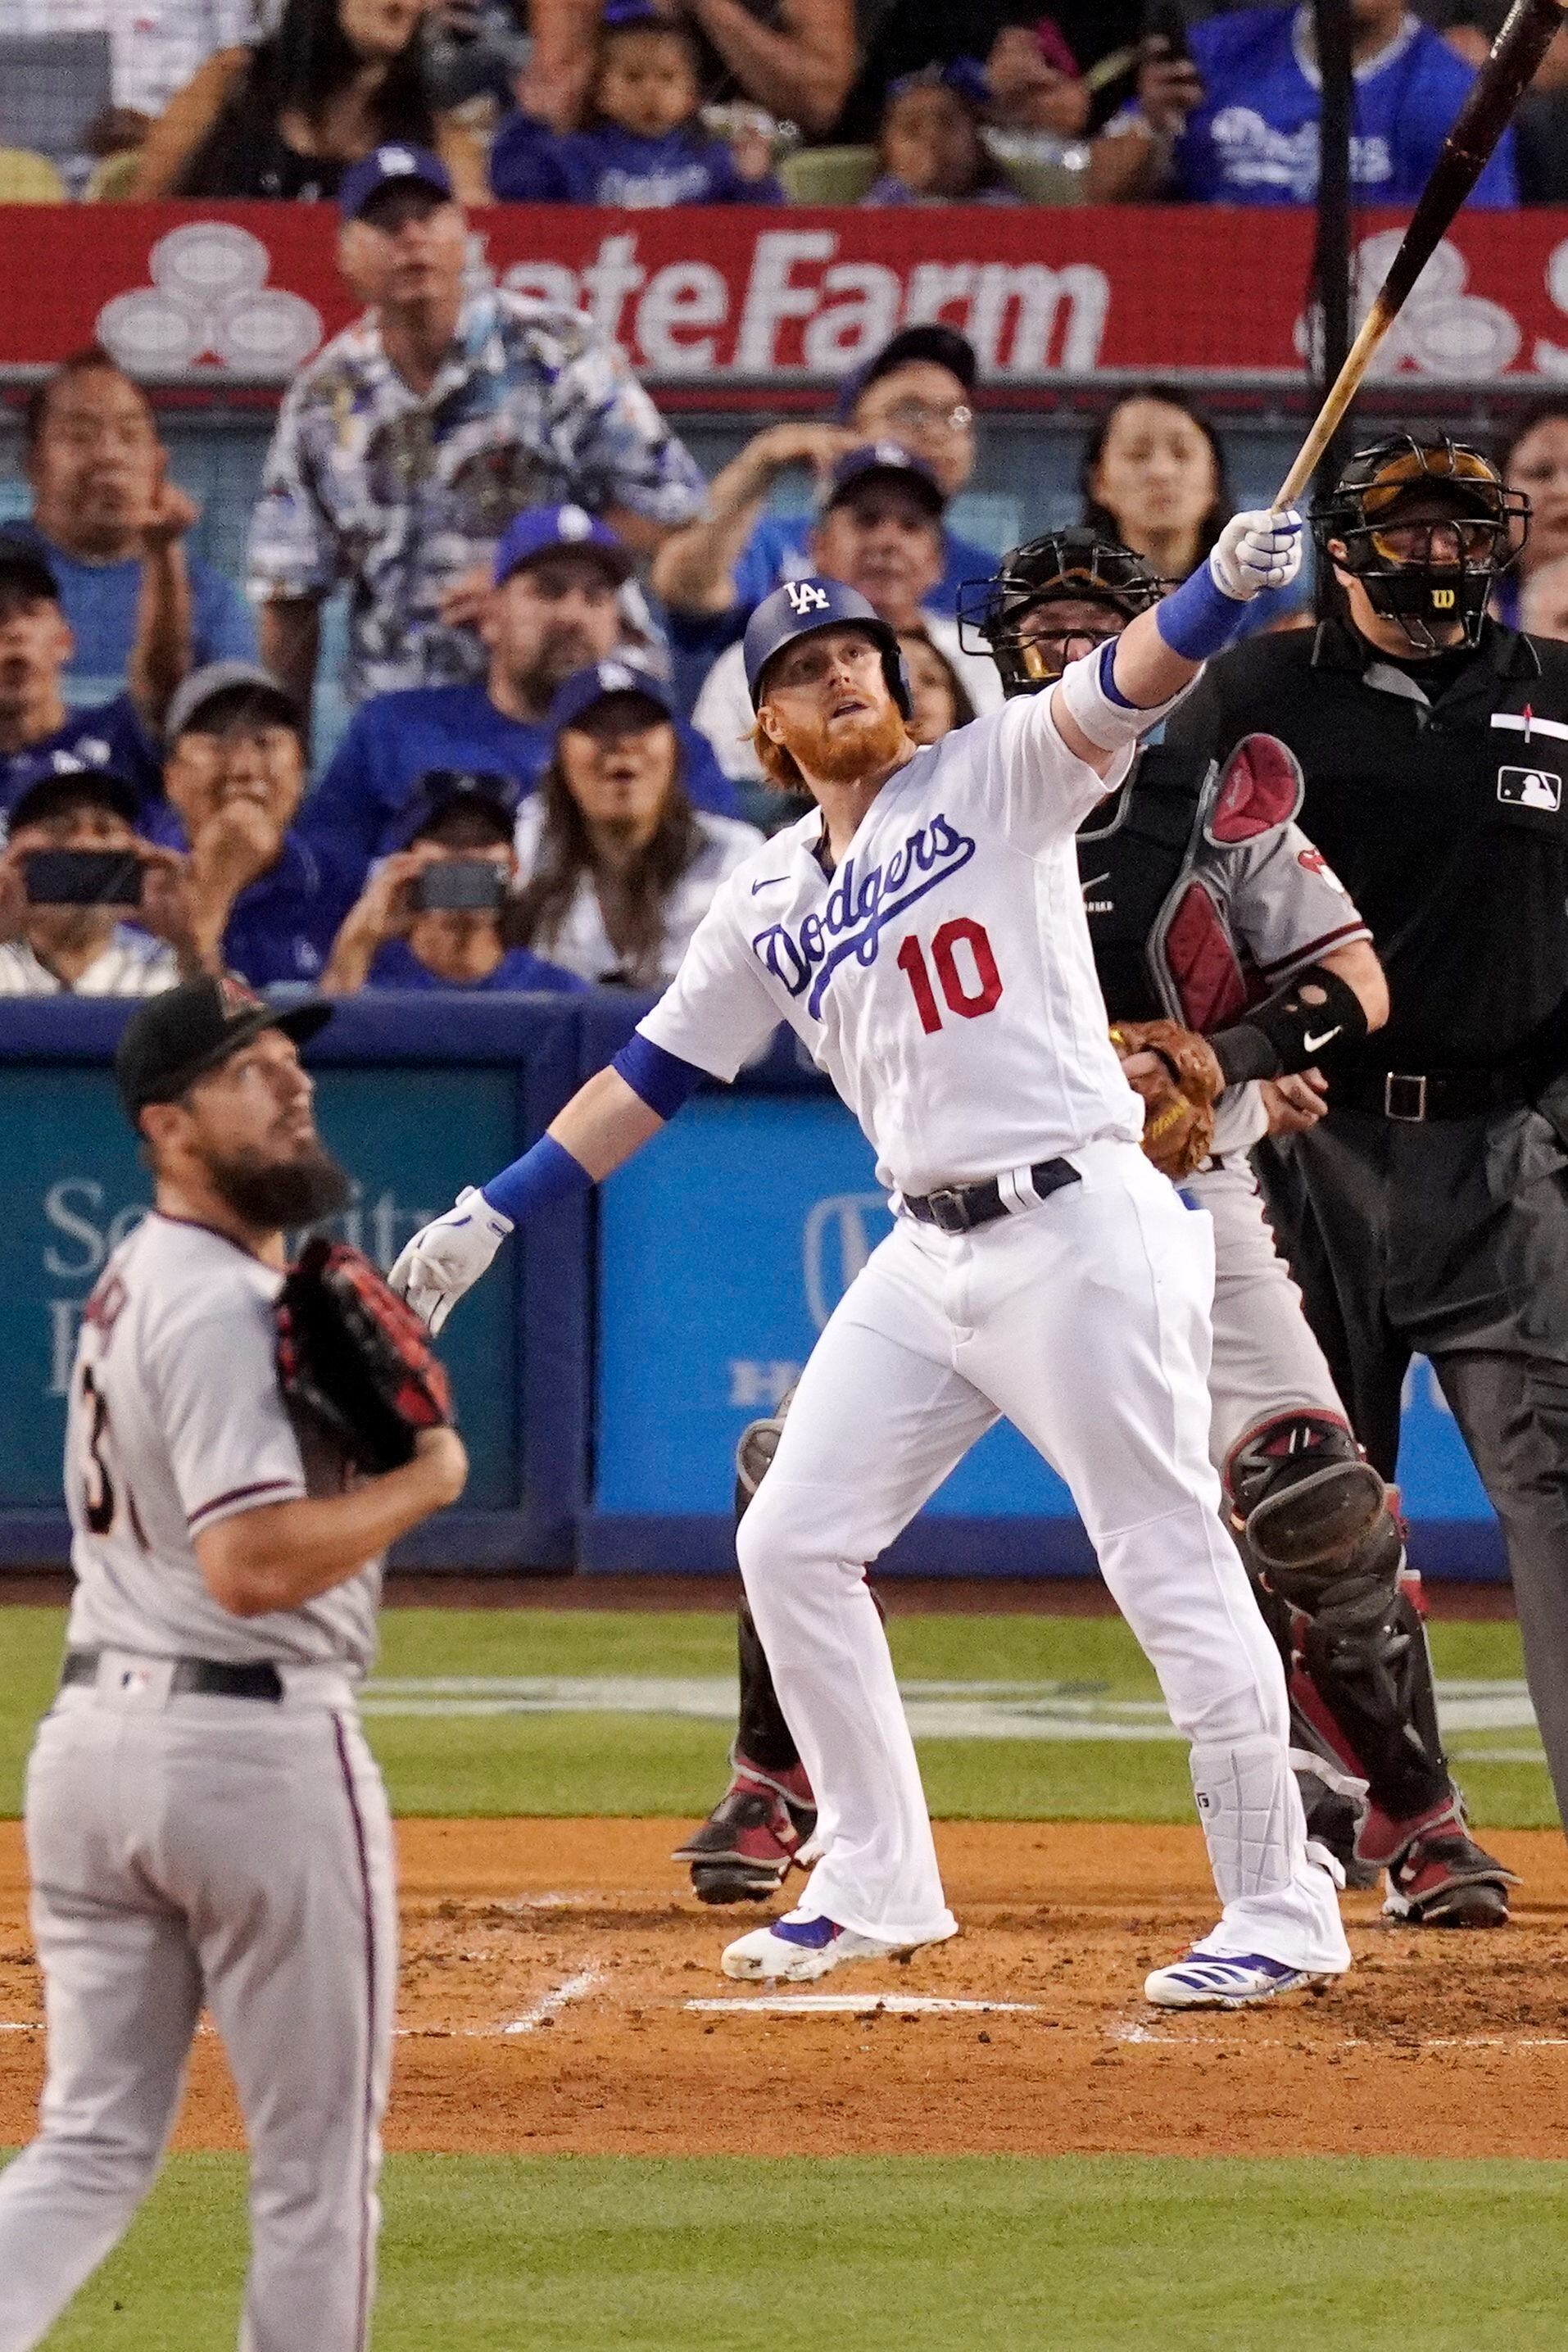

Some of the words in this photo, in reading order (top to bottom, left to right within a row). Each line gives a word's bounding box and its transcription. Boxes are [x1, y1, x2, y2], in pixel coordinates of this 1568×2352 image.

[783, 582, 831, 615] LA
[753, 813, 976, 1021] Dodgers
[897, 917, 1004, 1036] 10
